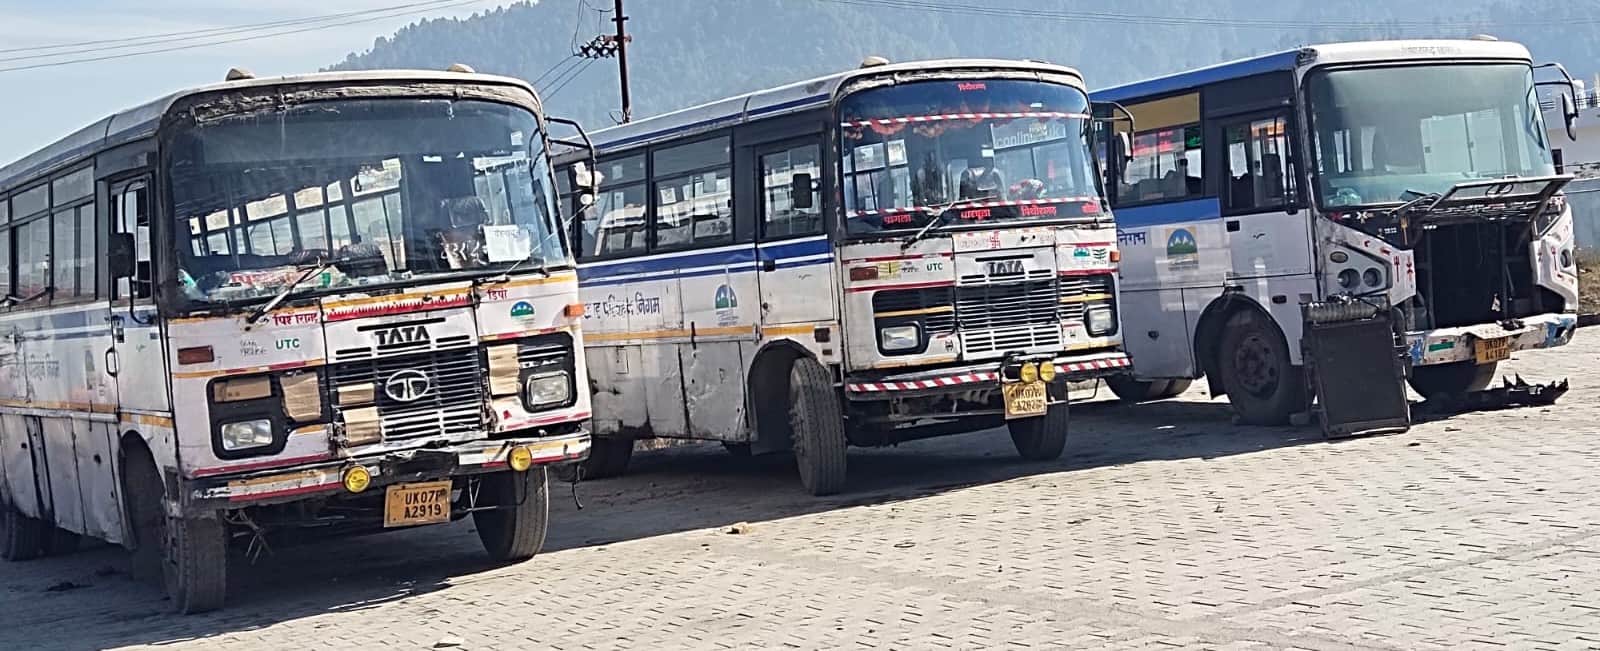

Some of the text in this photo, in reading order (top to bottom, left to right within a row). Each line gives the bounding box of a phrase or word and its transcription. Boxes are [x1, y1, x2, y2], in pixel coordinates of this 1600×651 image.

[1117, 228, 1146, 247] निगम
[926, 263, 943, 272] UTC
[986, 259, 1024, 275] TATA
[635, 291, 660, 316] निगम
[374, 326, 429, 345] TATA
[275, 339, 300, 350] UTC
[404, 504, 441, 518] A2919
